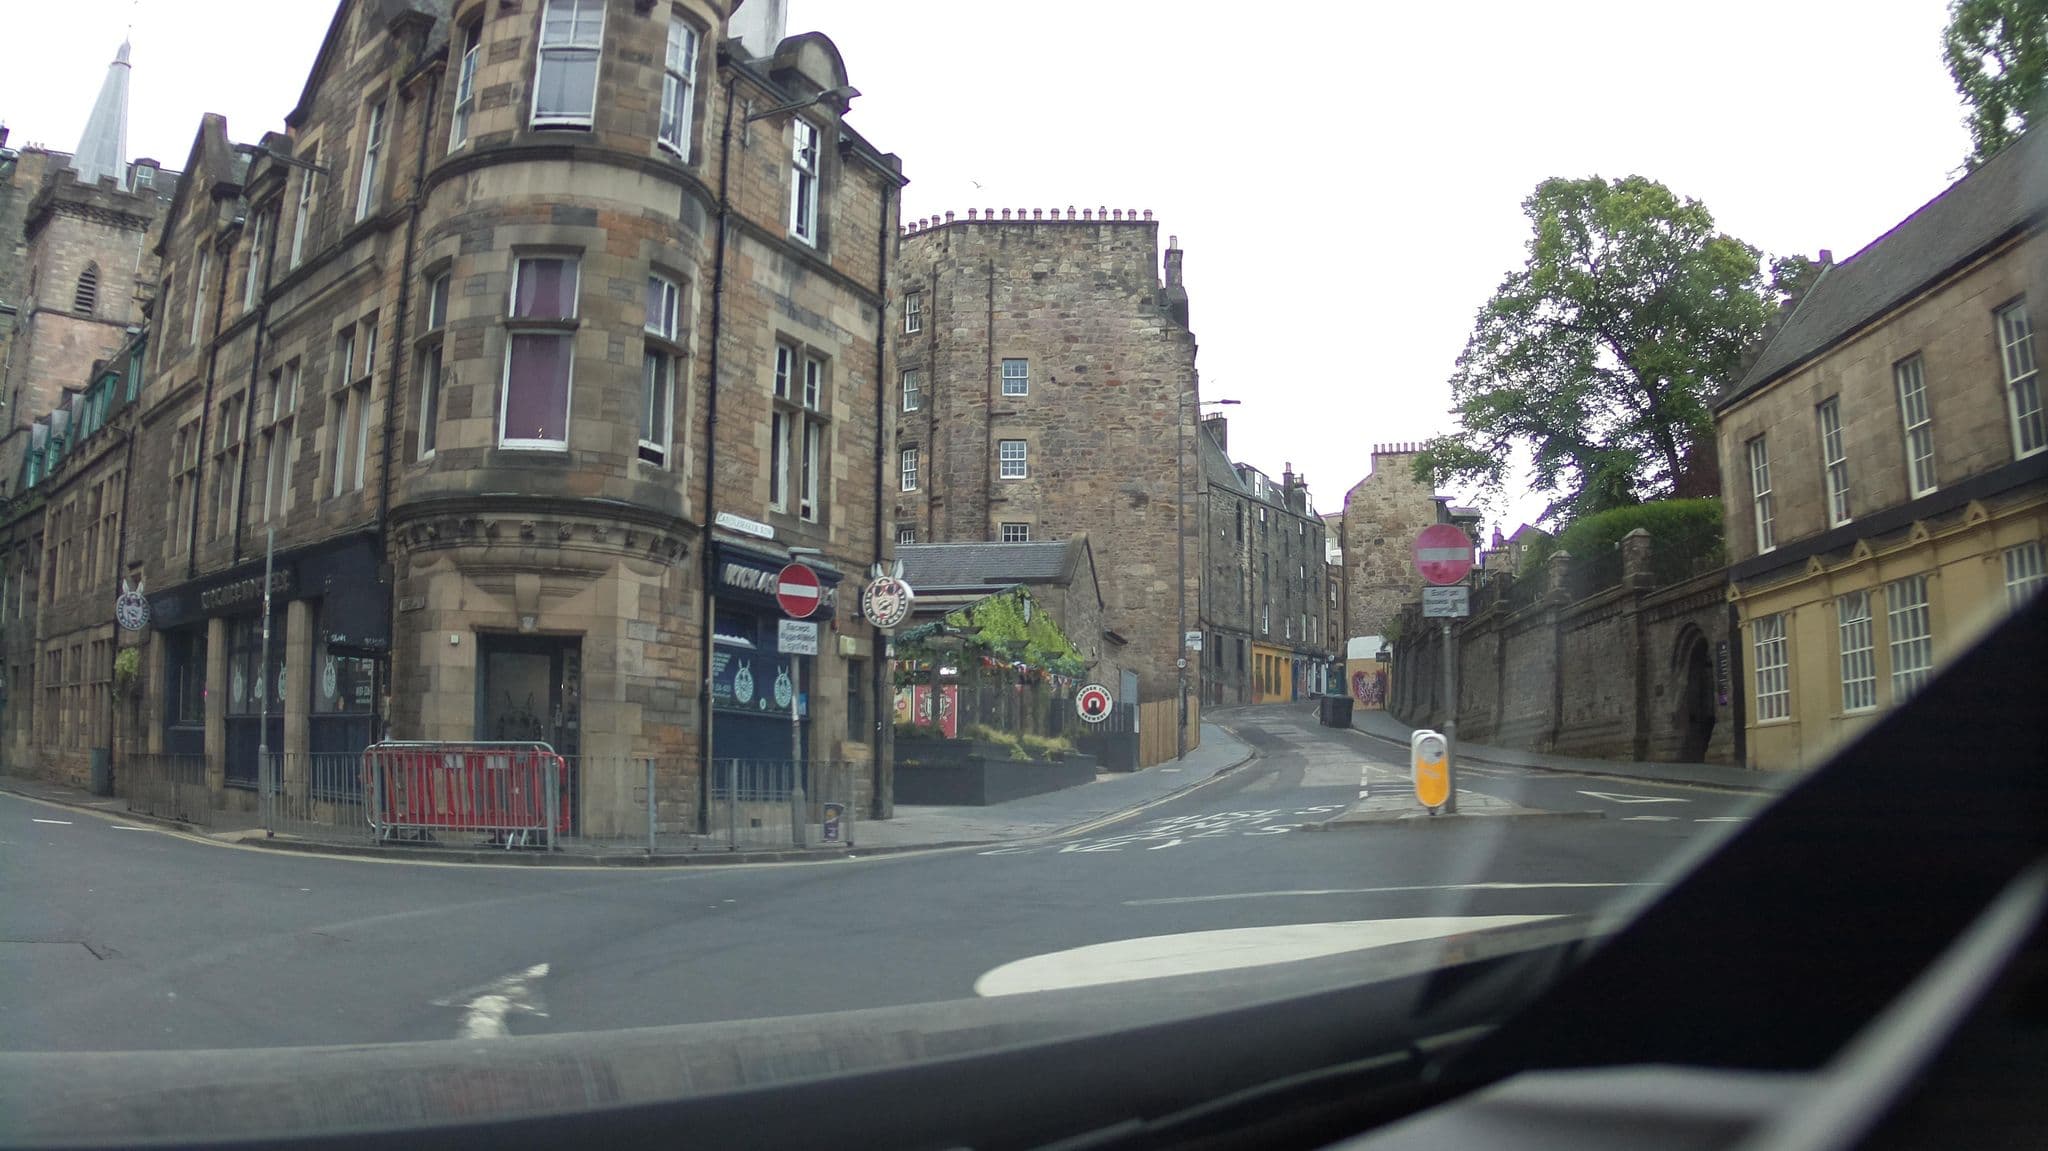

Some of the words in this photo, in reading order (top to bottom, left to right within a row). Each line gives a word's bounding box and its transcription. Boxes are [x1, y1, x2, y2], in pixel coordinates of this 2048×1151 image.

[725, 563, 759, 590] KICK
[1078, 686, 1097, 701] CAMDEN
[1098, 687, 1110, 701] TOWN
[1081, 712, 1107, 721] BREWERY
